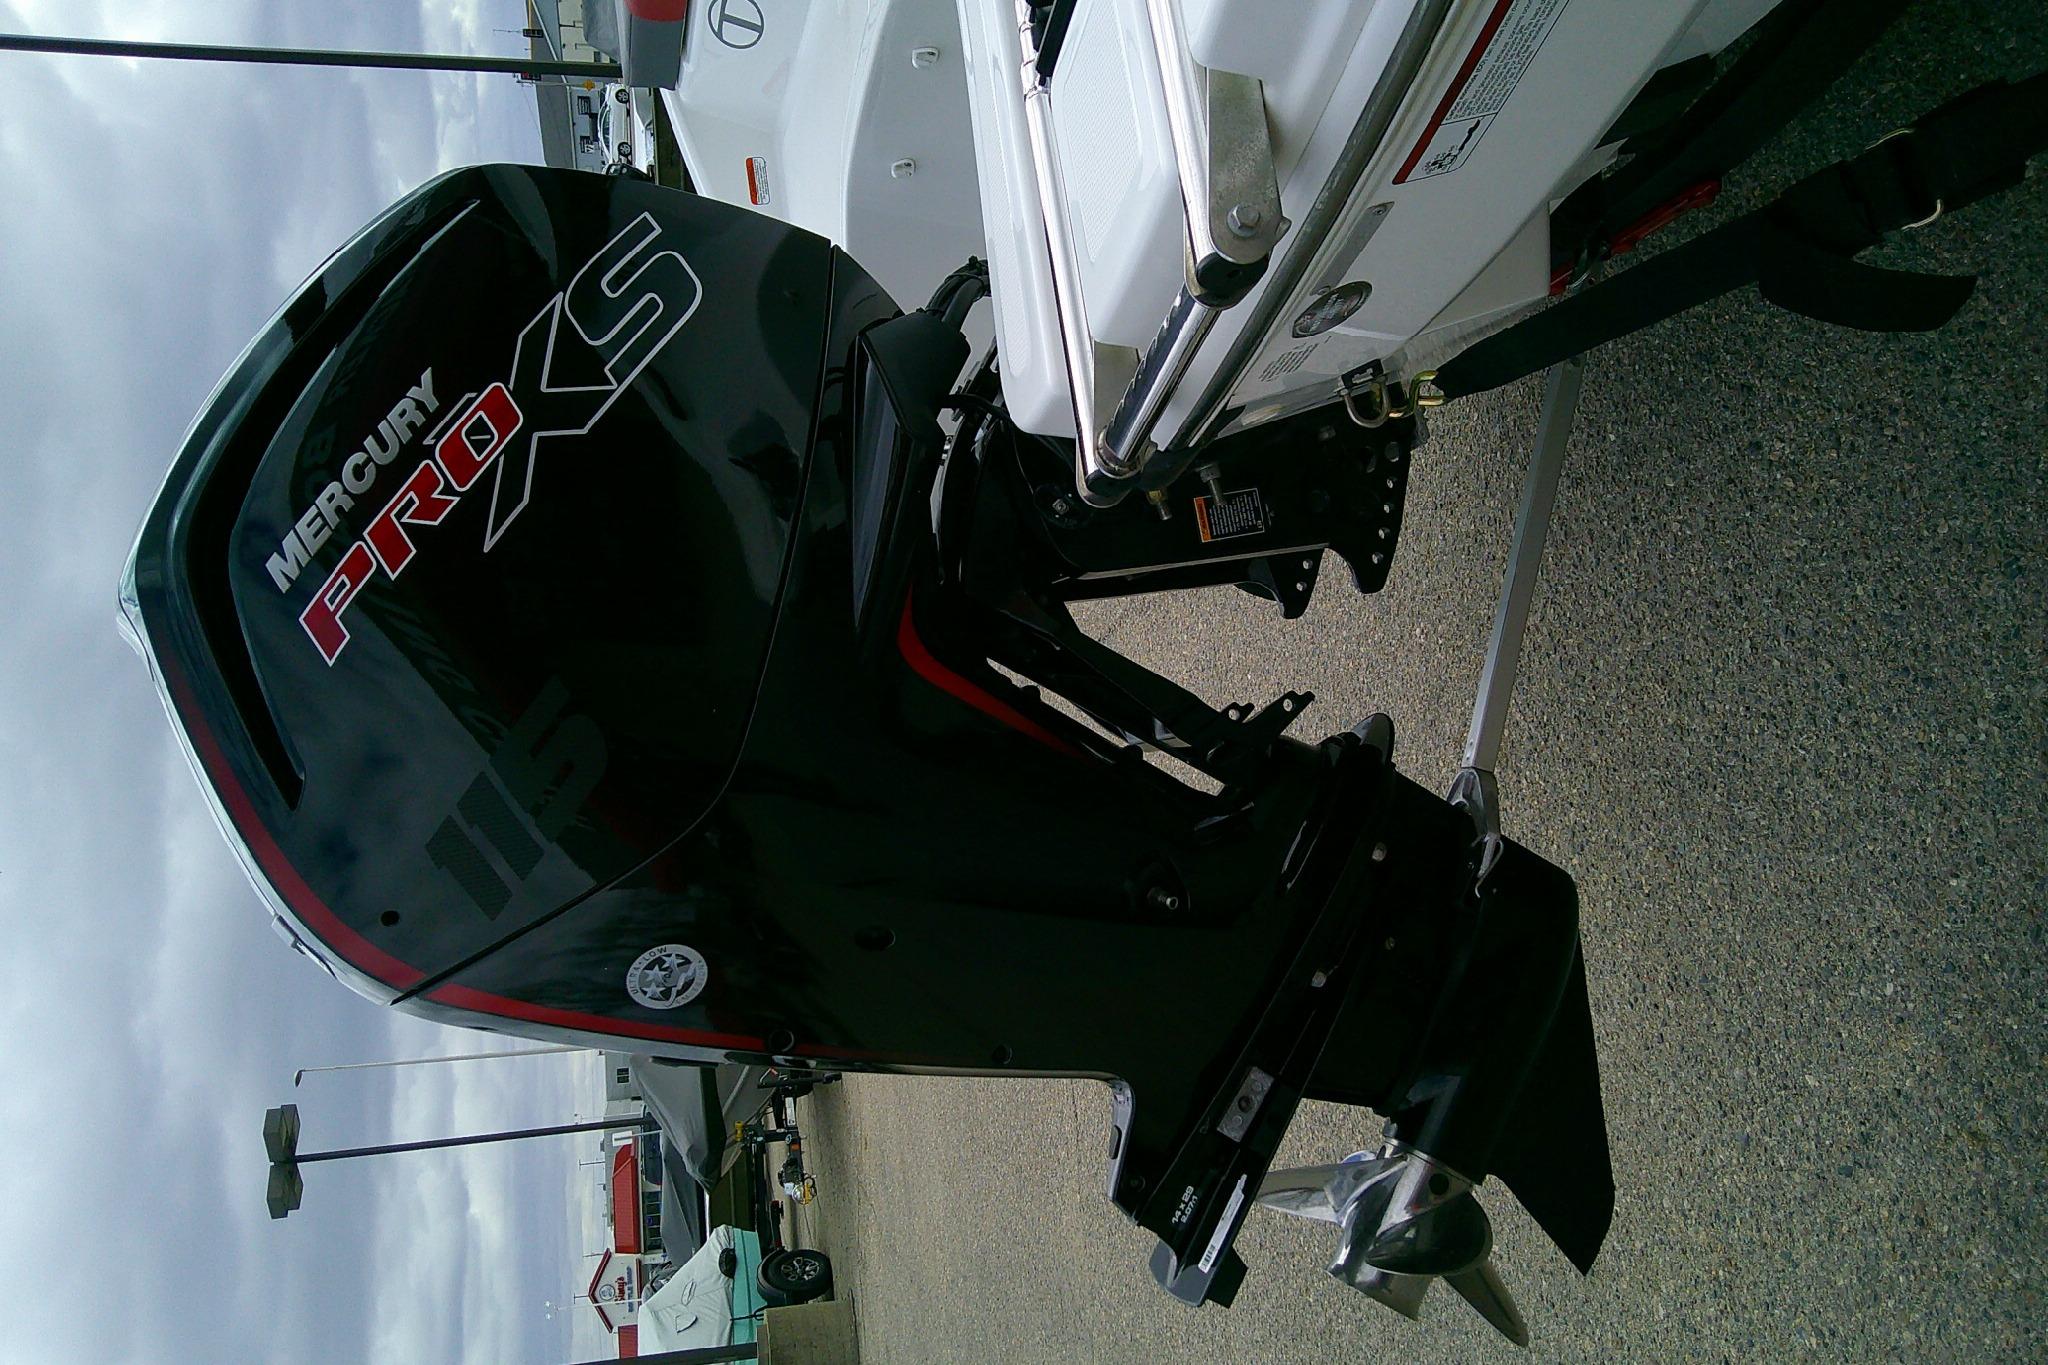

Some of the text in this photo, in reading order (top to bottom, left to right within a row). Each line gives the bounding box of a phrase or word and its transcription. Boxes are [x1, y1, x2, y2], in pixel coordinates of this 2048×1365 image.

[265, 366, 440, 595] MERCURY
[299, 211, 703, 668] PRO XS
